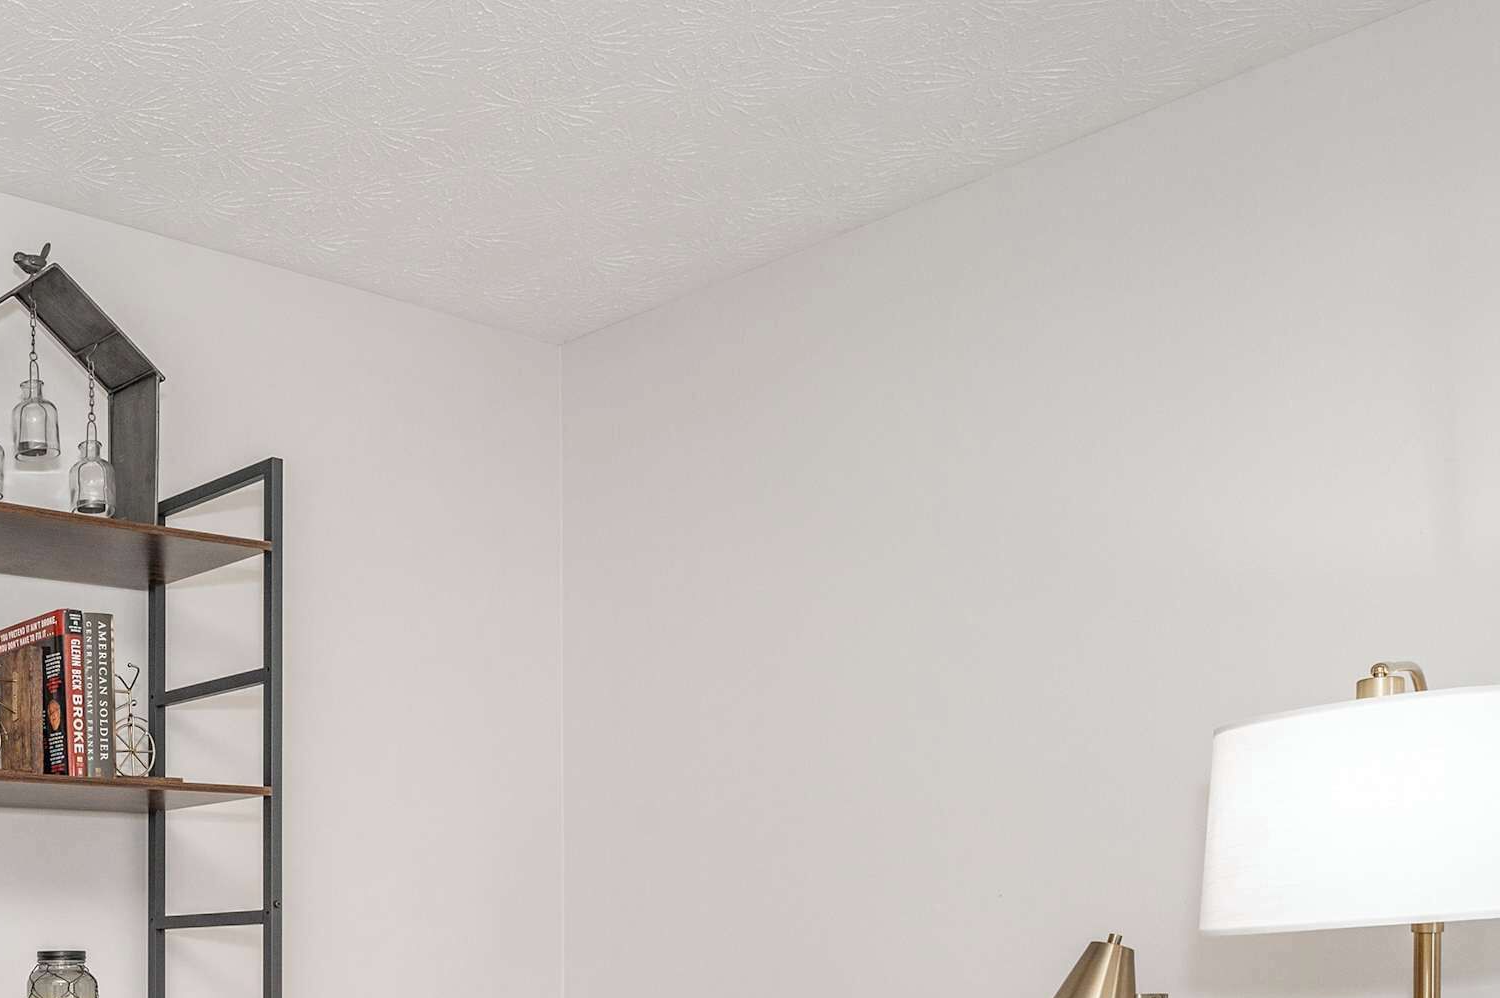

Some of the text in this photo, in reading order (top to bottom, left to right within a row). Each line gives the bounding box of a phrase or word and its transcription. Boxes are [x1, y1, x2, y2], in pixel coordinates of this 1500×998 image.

[0, 633, 8, 643] YOU
[8, 626, 26, 640] PRETEND
[30, 621, 41, 632] AIN'T
[7, 639, 19, 651] DON'T
[85, 621, 93, 669] GENERAL
[71, 638, 82, 667] GLENN
[72, 669, 82, 690] BECK
[98, 620, 109, 760] AMERICAN SOLDIER
[72, 694, 84, 754] BROKE
